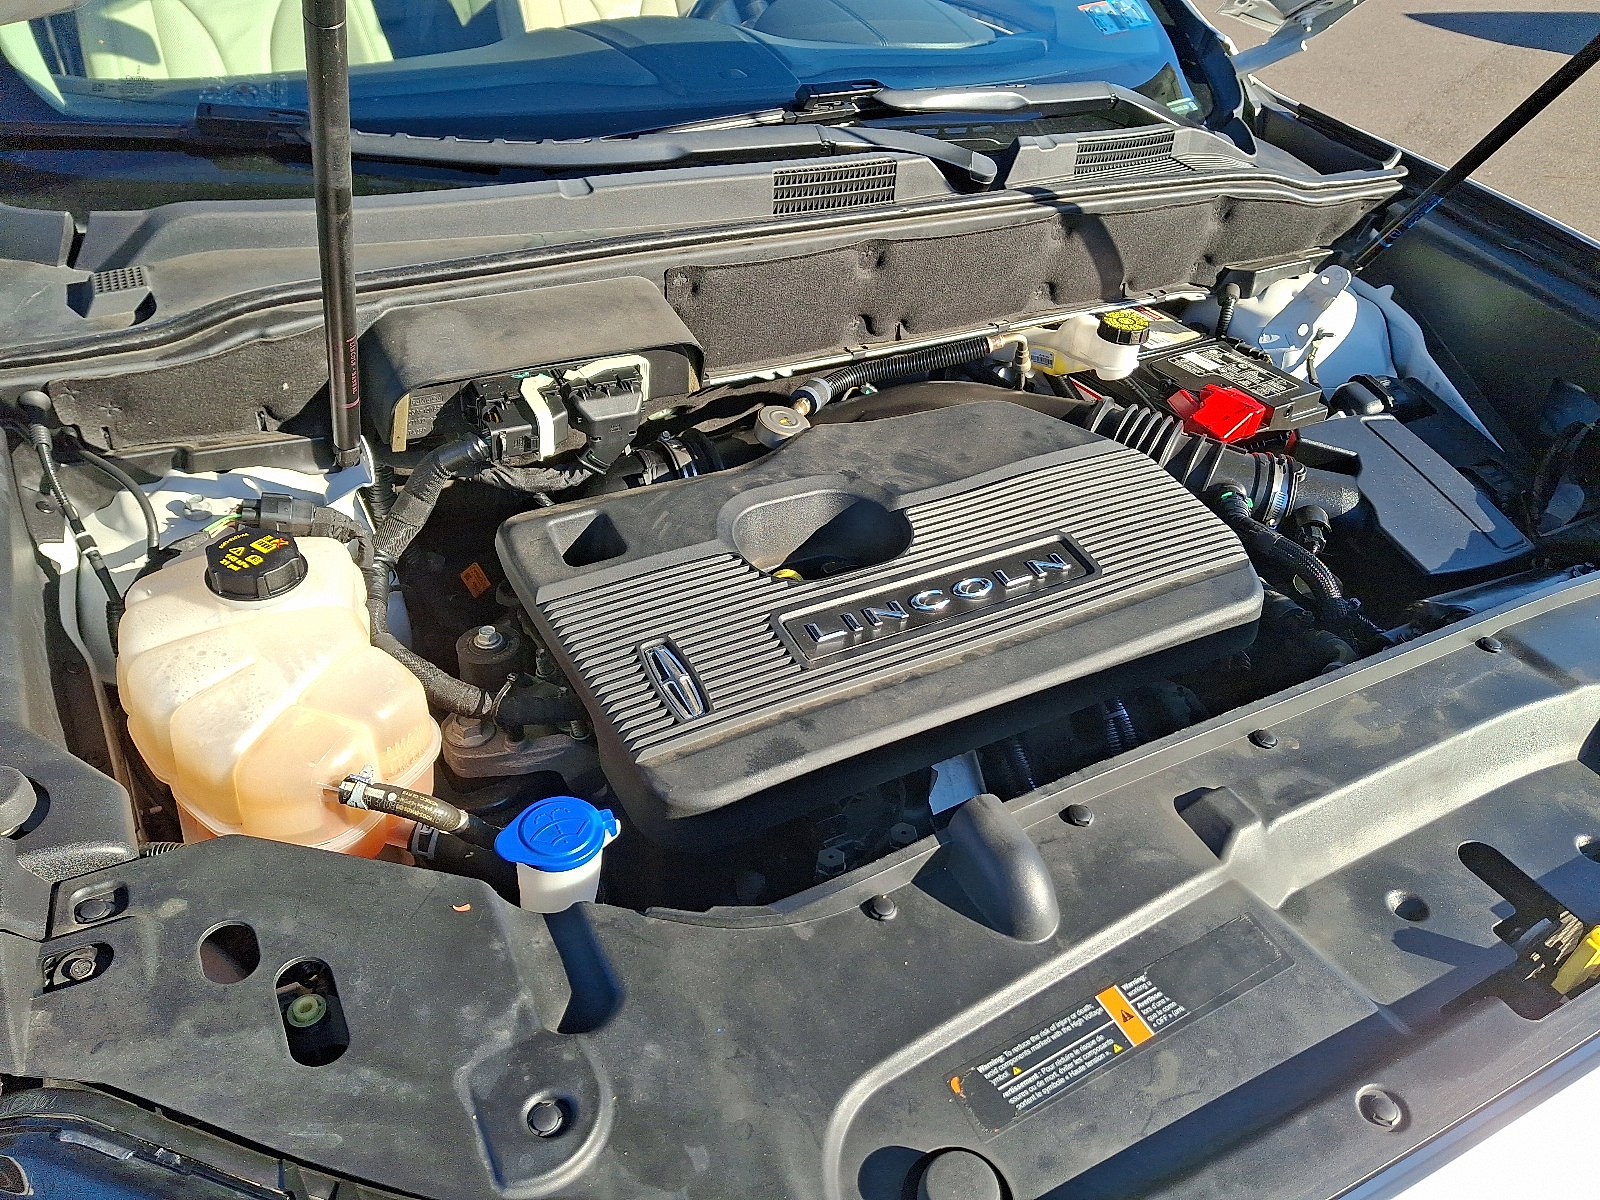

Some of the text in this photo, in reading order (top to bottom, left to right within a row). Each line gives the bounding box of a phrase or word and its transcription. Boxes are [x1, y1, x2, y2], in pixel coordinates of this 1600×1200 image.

[803, 552, 1072, 643] LINCOLN
[1121, 974, 1147, 991] Warning:
[998, 1049, 1032, 1070] components
[1030, 1037, 1052, 1051] marked
[1050, 1030, 1063, 1040] with
[1061, 1025, 1072, 1033] the
[1070, 1017, 1085, 1028] High
[1083, 1006, 1105, 1021] Voltage
[1156, 1015, 1169, 1024] OFF
[977, 1054, 1005, 1073] Warning:
[1011, 1039, 1031, 1053] reduce
[1030, 1034, 1040, 1042] the
[1039, 1028, 1050, 1036] risk
[1055, 1016, 1072, 1028] injury
[1041, 1063, 1056, 1074] Pour
[1054, 1051, 1075, 1066] réduire
[1079, 1039, 1097, 1051] risque
[1073, 1056, 1083, 1064] les
[1082, 1038, 1115, 1059] composants
[1041, 1077, 1066, 1094] symbole
[1068, 1064, 1087, 1077] Haute
[1085, 1053, 1106, 1067] tension
